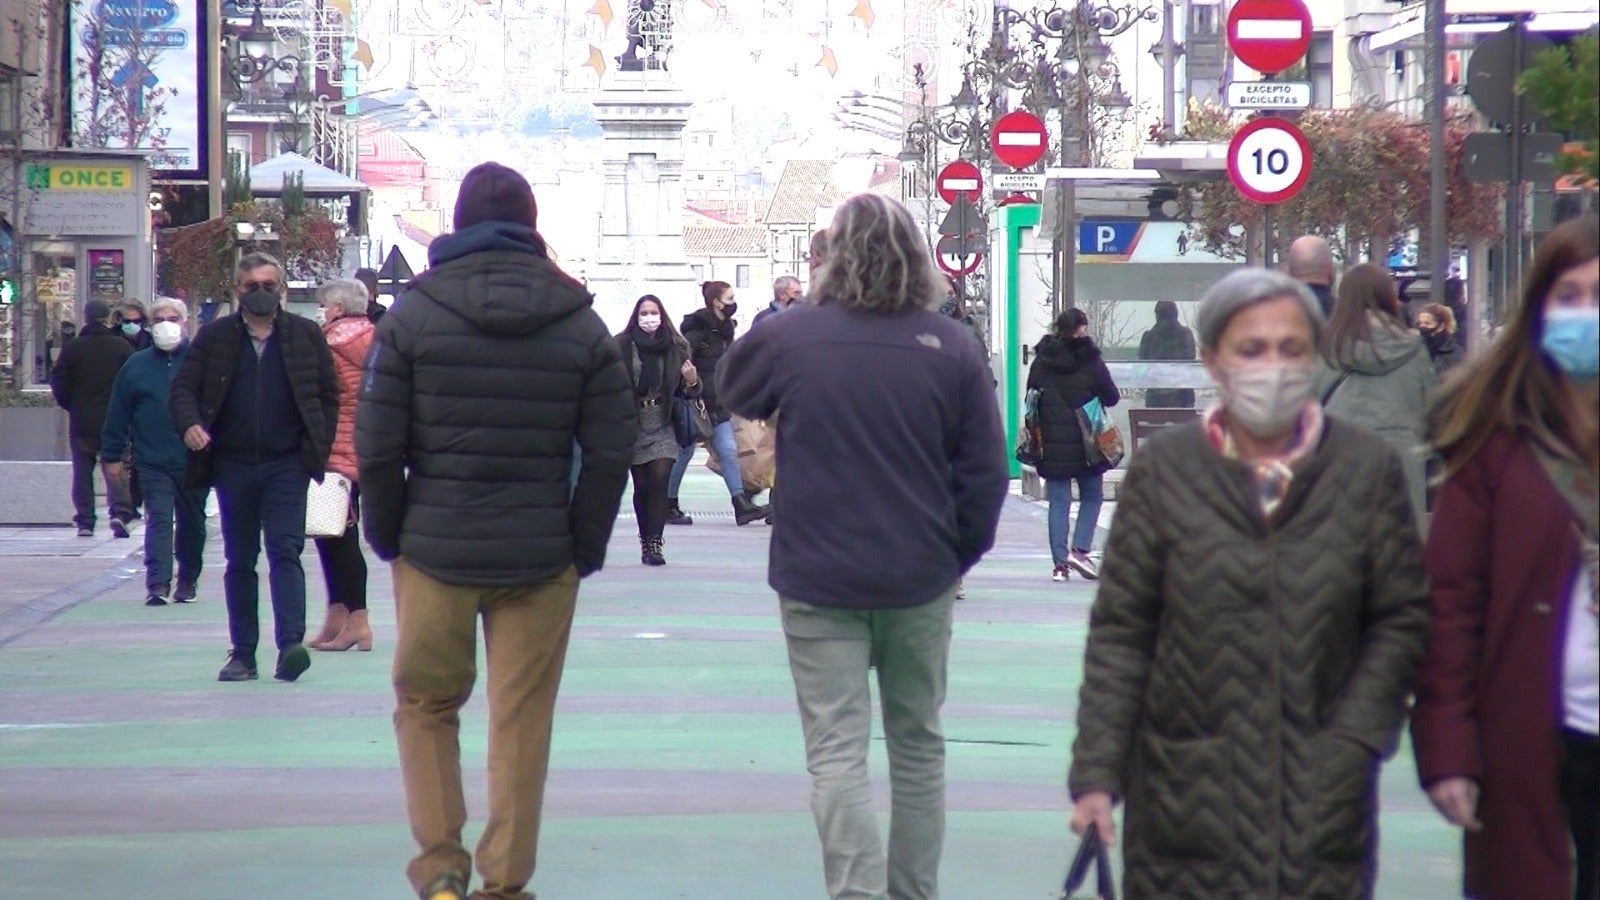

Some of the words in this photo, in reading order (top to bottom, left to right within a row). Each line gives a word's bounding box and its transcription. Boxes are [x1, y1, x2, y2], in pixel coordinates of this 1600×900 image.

[1252, 147, 1289, 175] 10
[59, 170, 124, 186] ONCE
[1097, 226, 1116, 252] P
